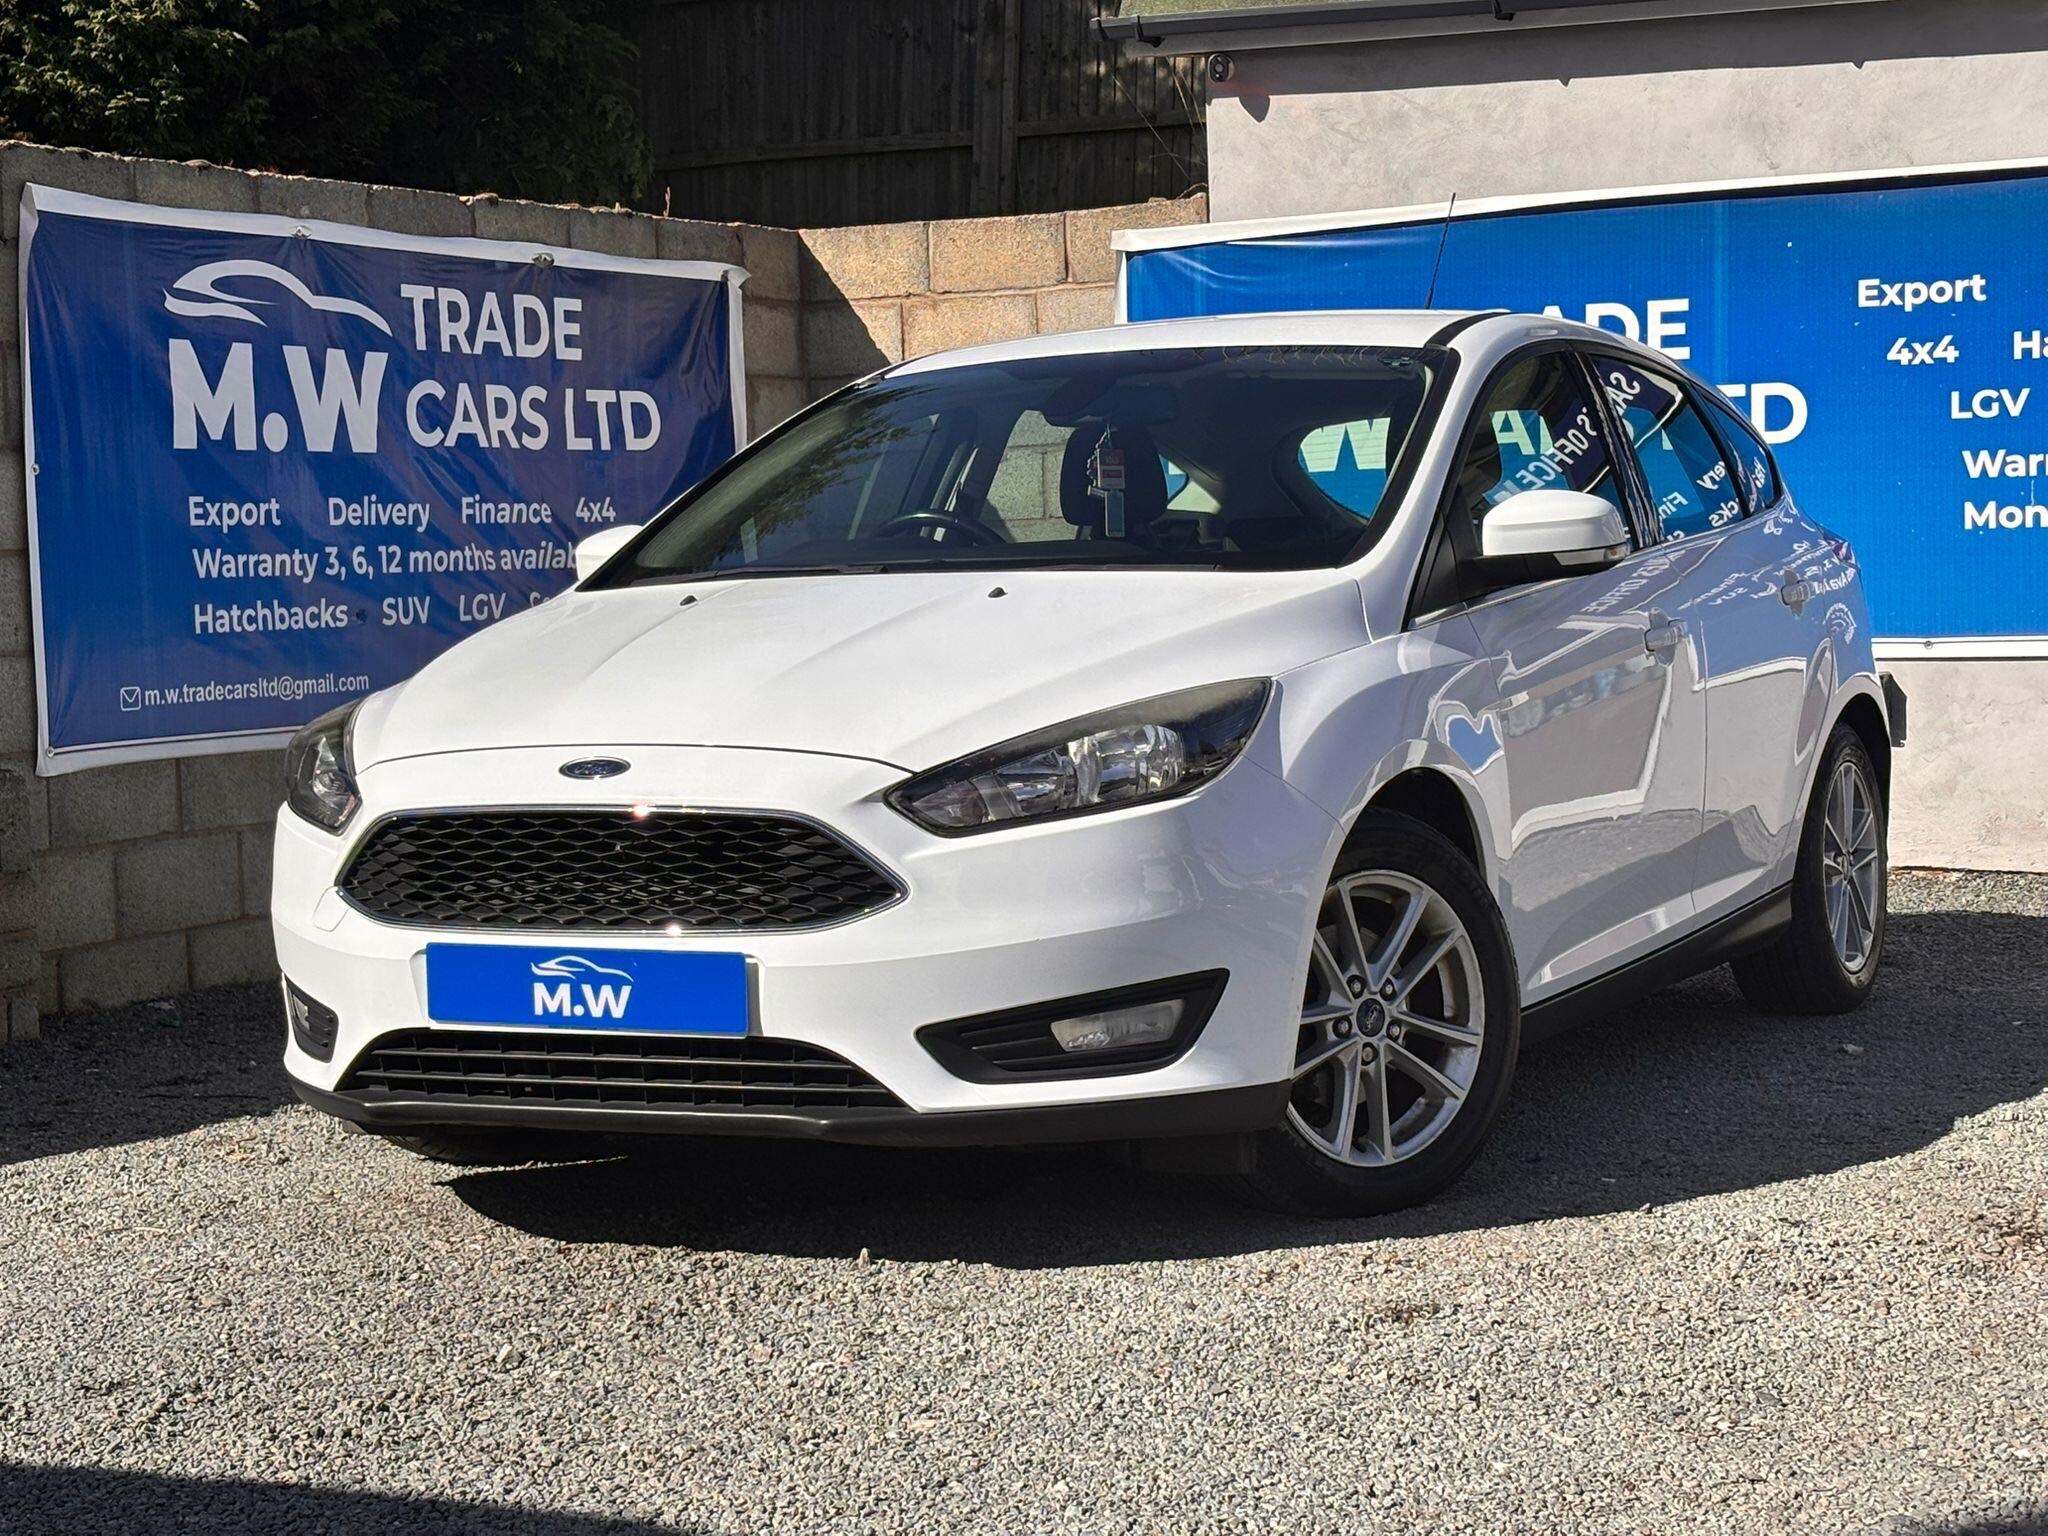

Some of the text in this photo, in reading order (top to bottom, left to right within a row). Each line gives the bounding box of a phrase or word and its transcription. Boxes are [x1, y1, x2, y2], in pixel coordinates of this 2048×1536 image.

[1857, 274, 1987, 312] Export
[400, 283, 583, 361] TRADE
[1886, 335, 1960, 366] 4x4
[168, 338, 389, 453] M.W
[406, 379, 662, 452] CARS LTD
[1951, 387, 2031, 420] LGV
[188, 494, 616, 534] Export Delivery Finance 4x4
[192, 548, 319, 584] Warranty
[325, 546, 346, 581] 3,
[352, 545, 374, 580] 6,
[378, 544, 402, 574] 12
[409, 542, 496, 573] months
[194, 598, 349, 634] Hatchbacks
[382, 595, 431, 627] SUV
[459, 591, 507, 622] LGV
[144, 673, 370, 706] m.w.tradecarsltd@gmail.com
[533, 982, 632, 1018] M.W
